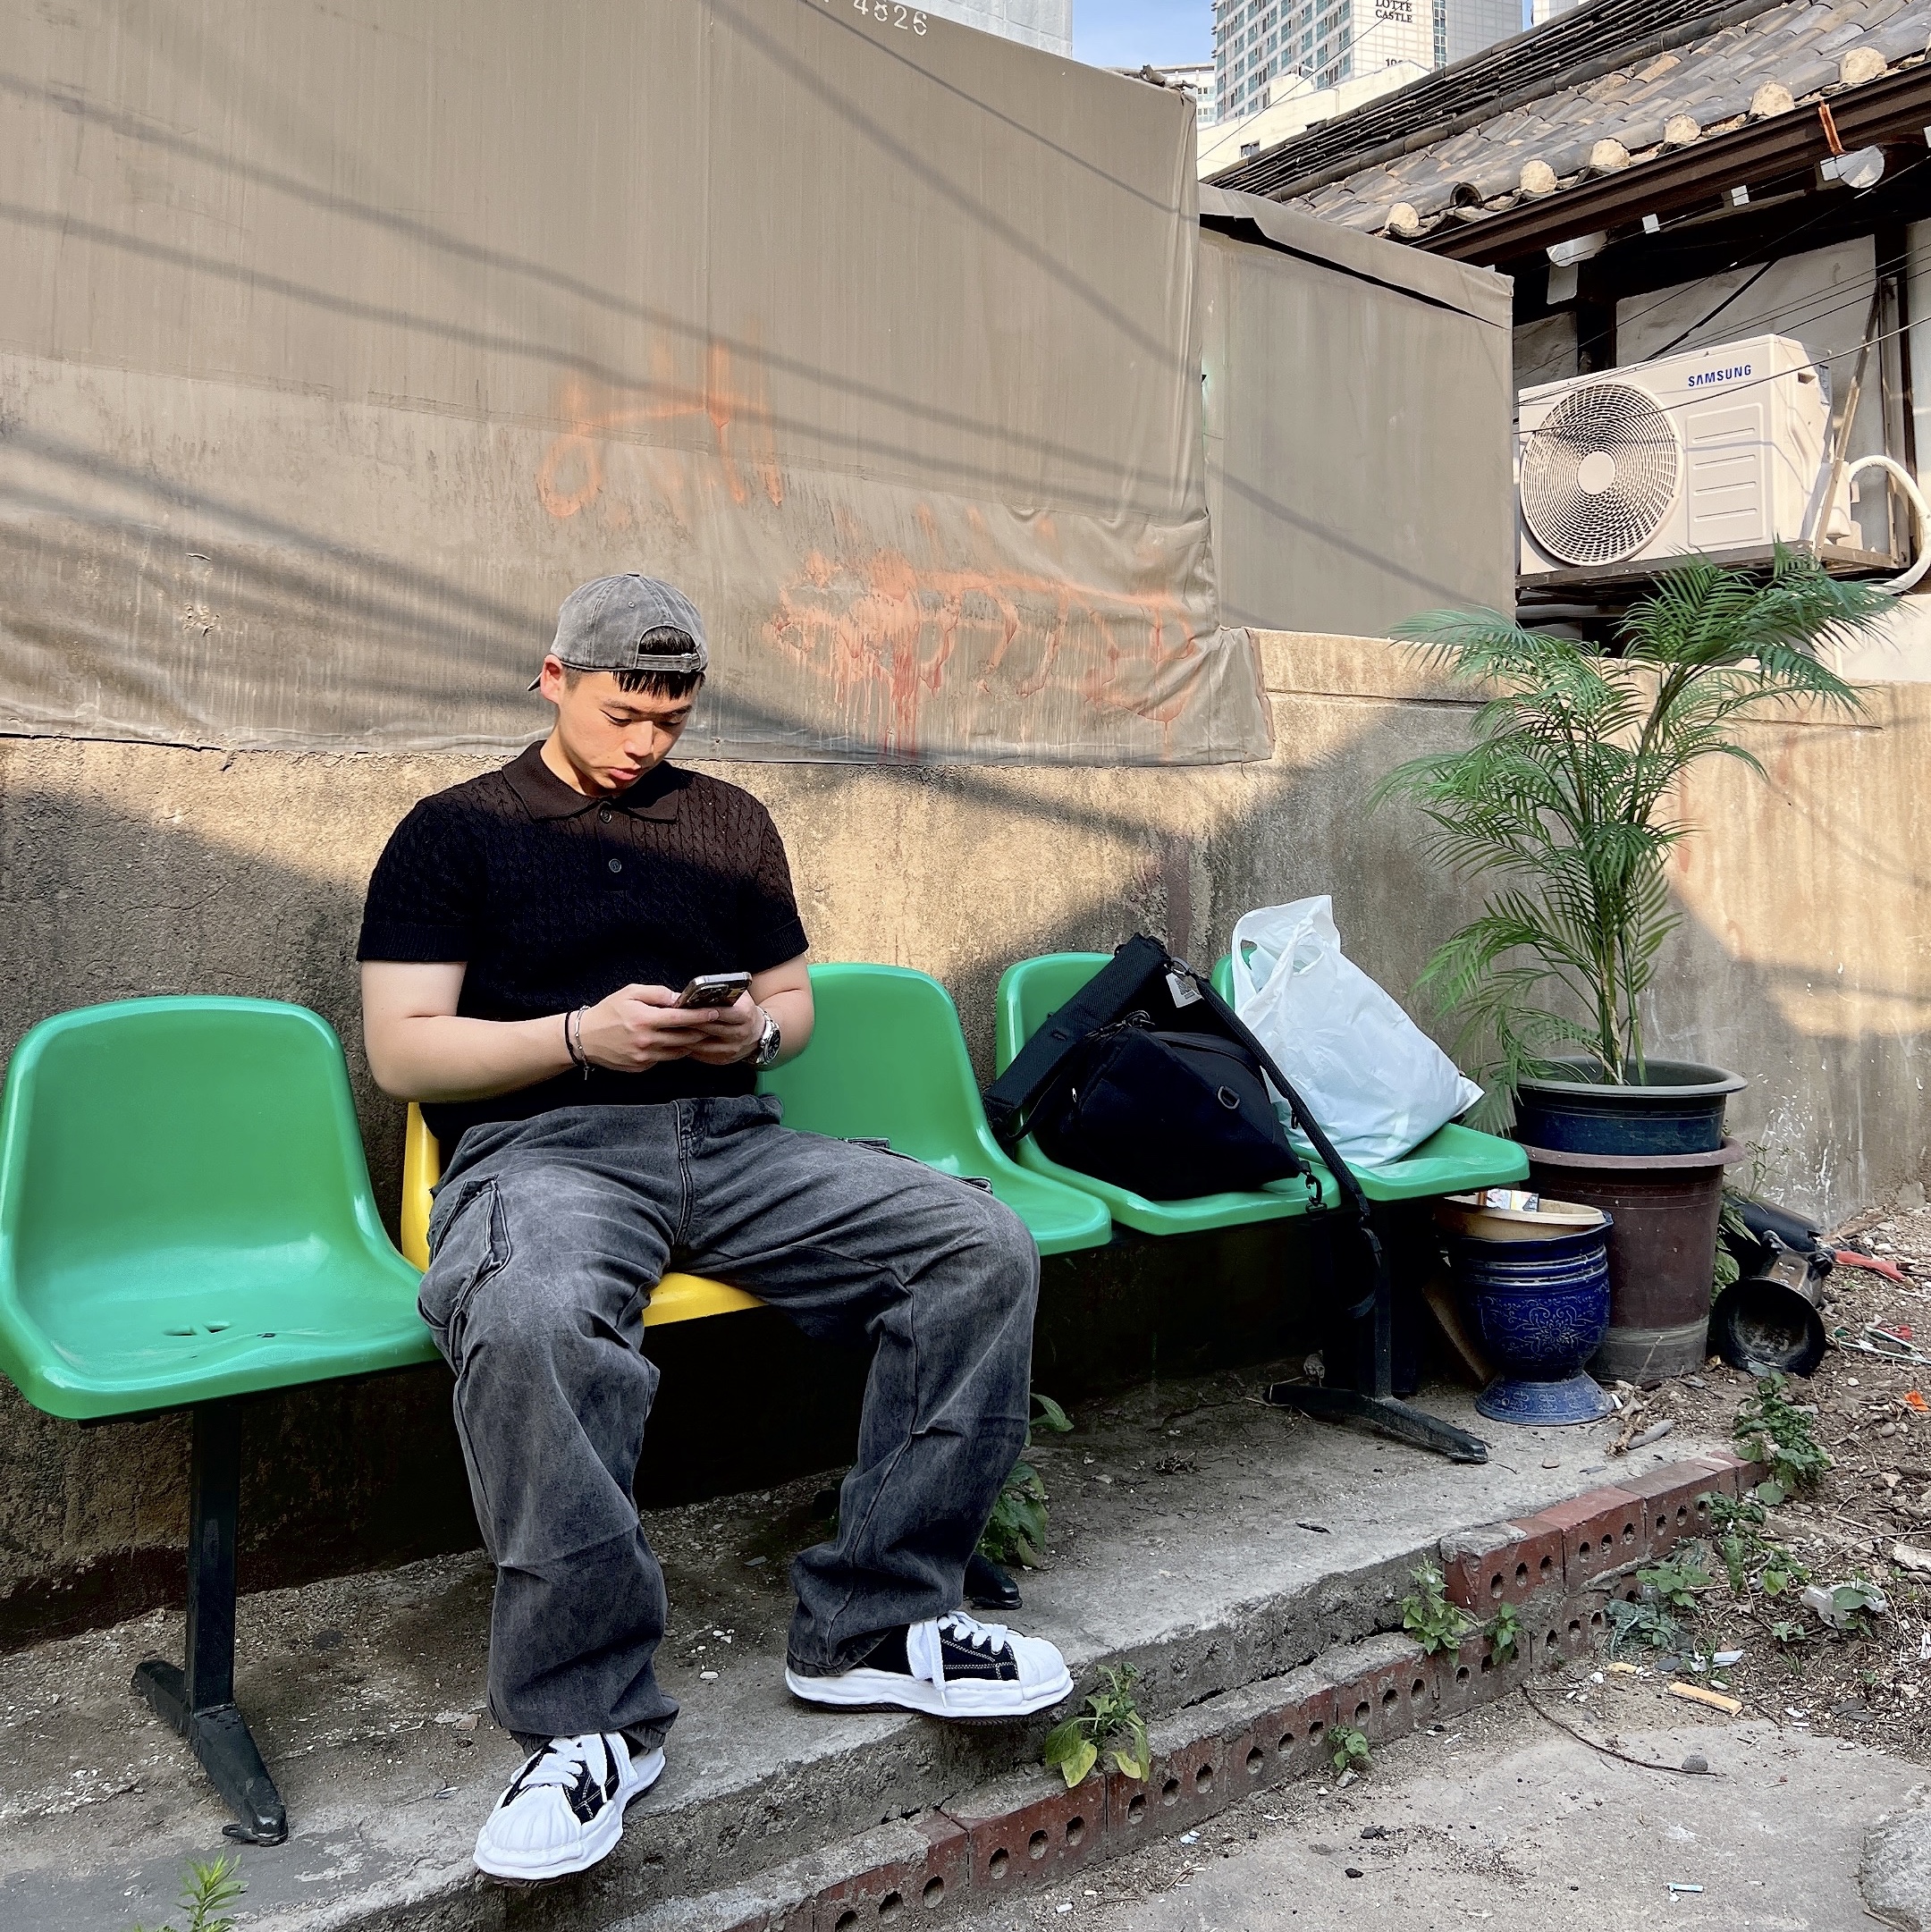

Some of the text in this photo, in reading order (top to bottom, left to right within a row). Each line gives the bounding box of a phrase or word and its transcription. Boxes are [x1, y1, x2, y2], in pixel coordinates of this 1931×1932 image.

[1375, 0, 1412, 13] LOTTE
[1375, 9, 1412, 23] CASTLE
[1385, 57, 1404, 67] 10
[1688, 364, 1752, 387] SAMSUNG
